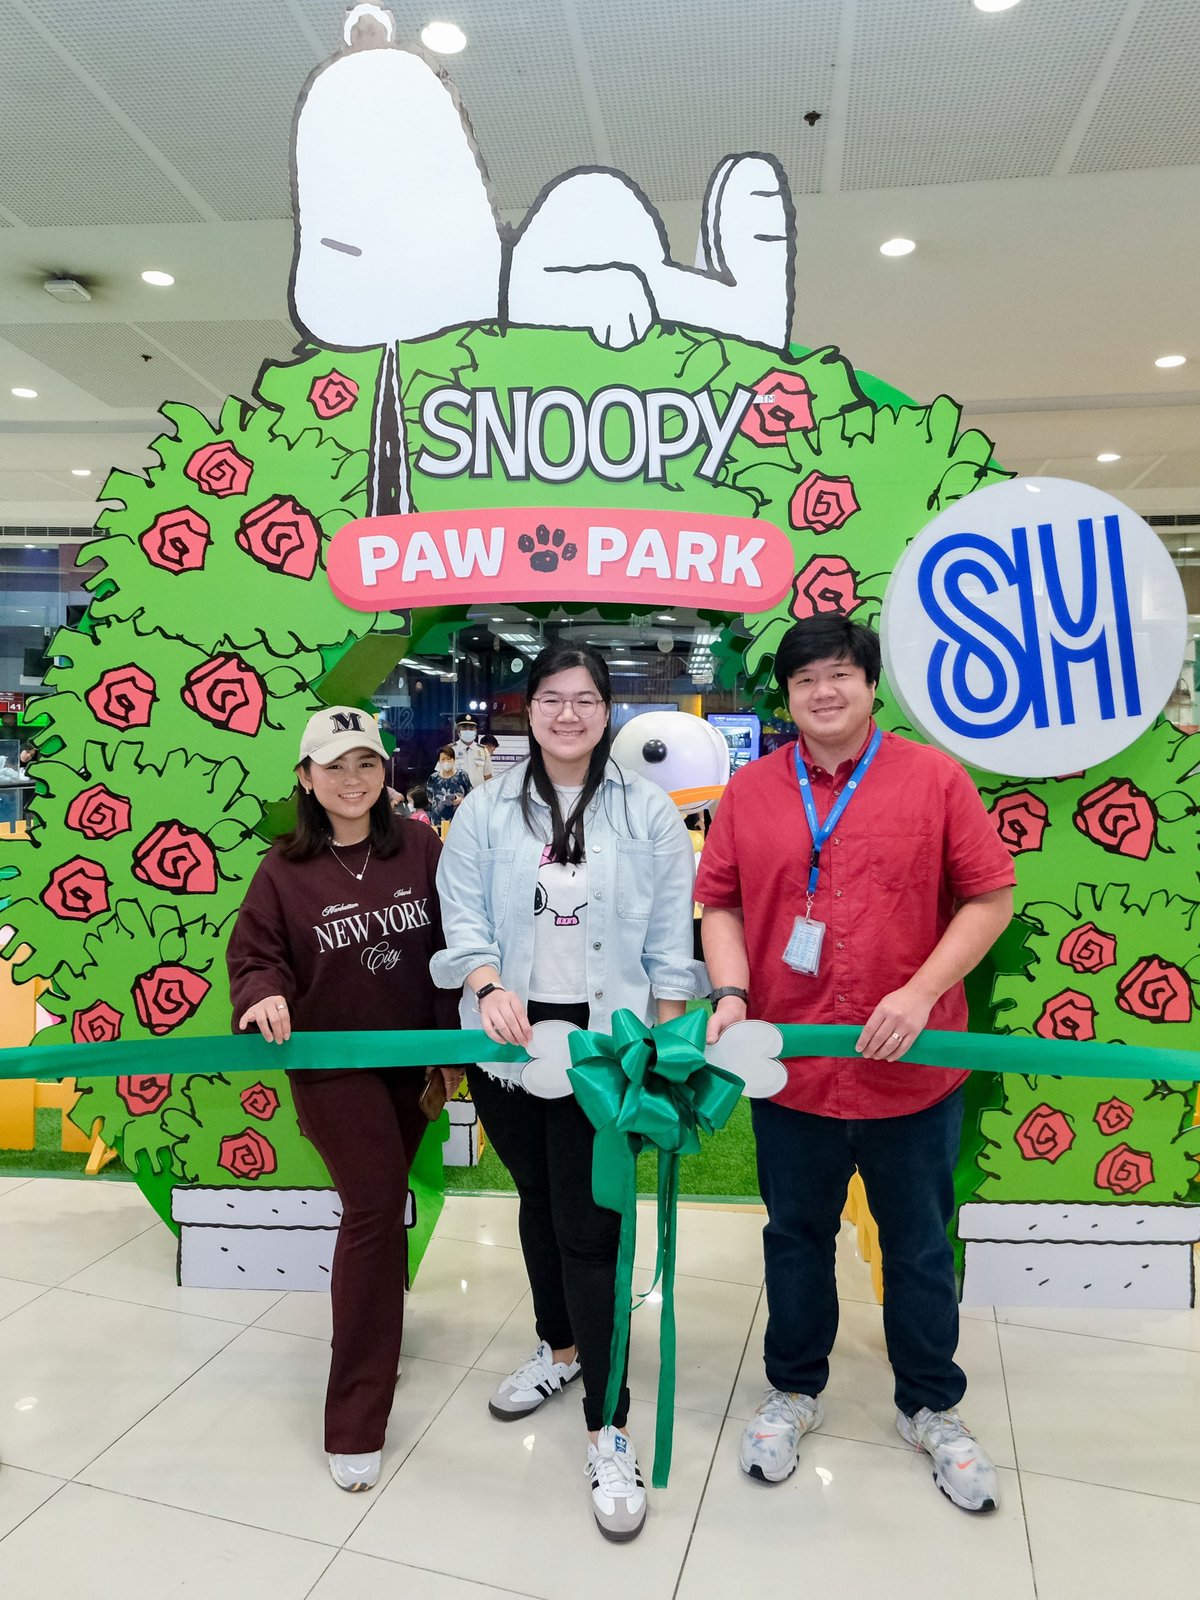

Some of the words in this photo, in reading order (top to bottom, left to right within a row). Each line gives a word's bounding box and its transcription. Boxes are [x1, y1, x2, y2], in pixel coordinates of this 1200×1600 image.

[414, 383, 757, 484] SNOOPY
[358, 527, 505, 586] PAW
[587, 527, 766, 587] PARK
[918, 514, 1142, 739] SM
[329, 712, 366, 734] M
[312, 912, 370, 953] NEW
[373, 898, 431, 936] YORK
[360, 941, 402, 975] City
